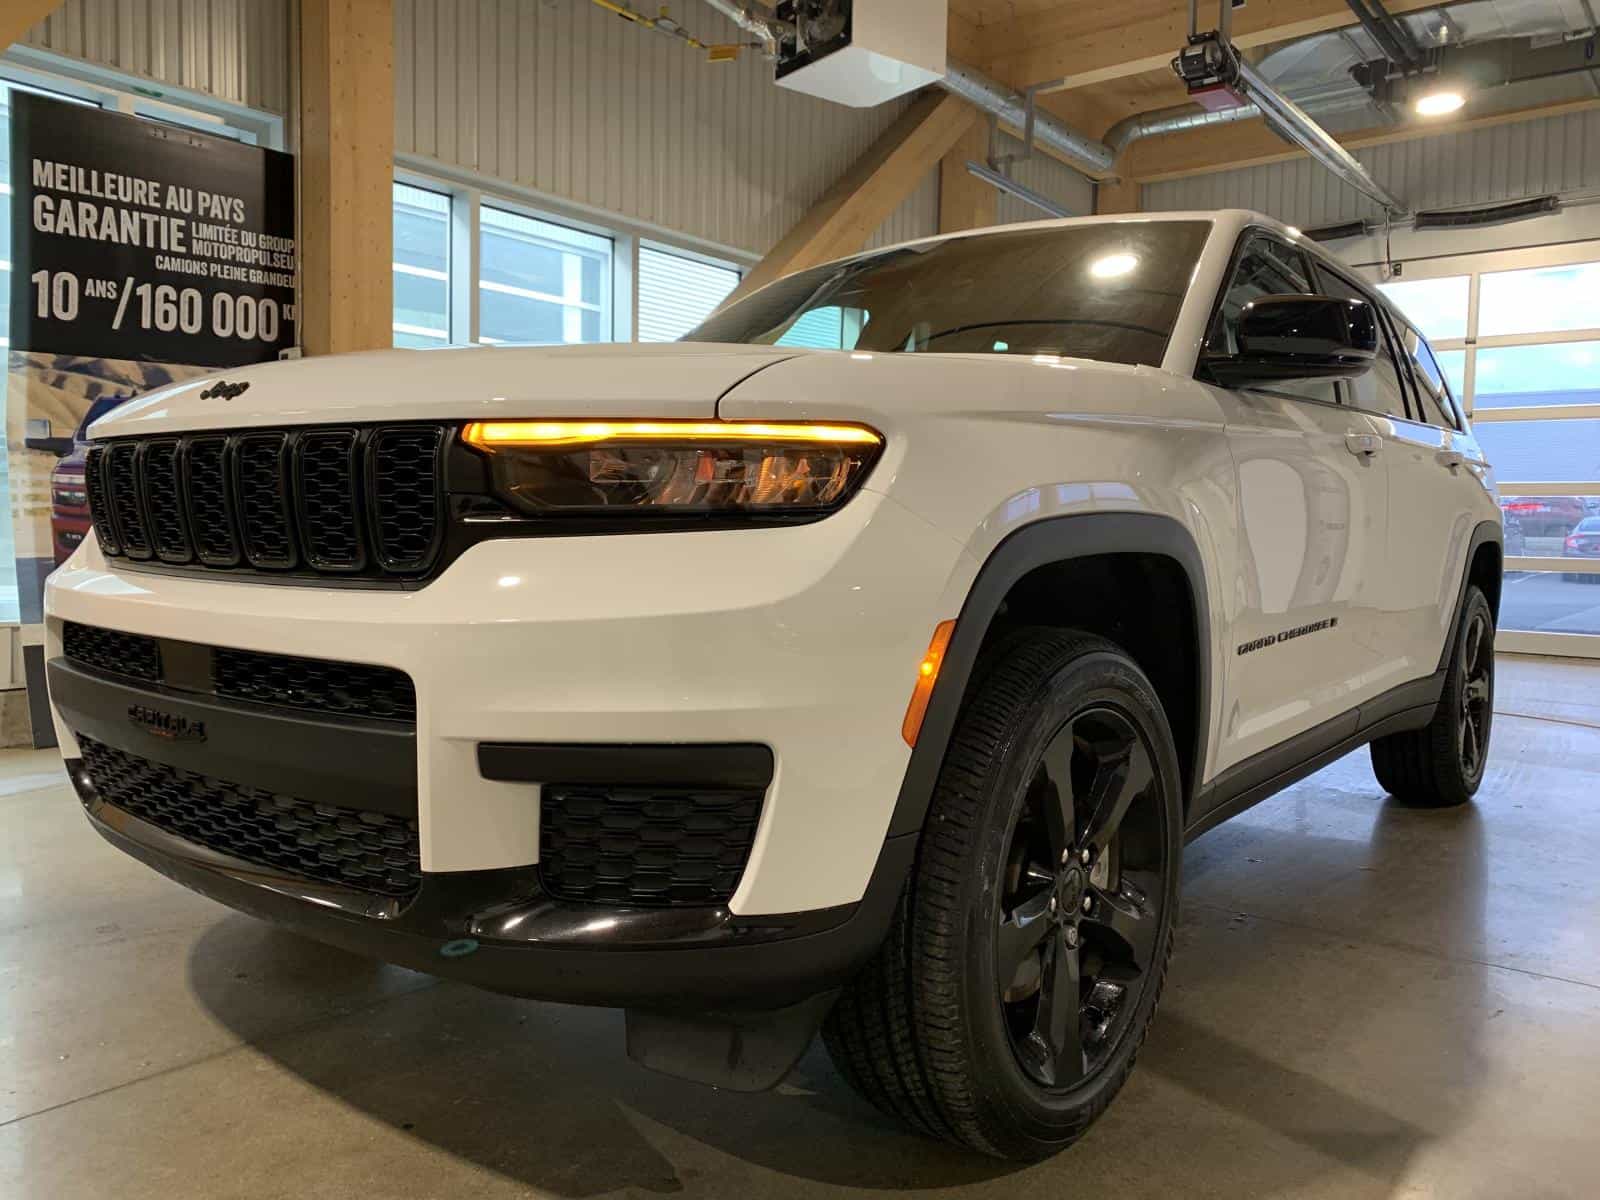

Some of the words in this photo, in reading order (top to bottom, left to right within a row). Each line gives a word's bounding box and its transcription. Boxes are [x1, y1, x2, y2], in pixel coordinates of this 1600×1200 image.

[33, 159, 161, 208] MEILLEURE
[166, 185, 192, 213] AU
[198, 191, 245, 223] PAYS
[33, 194, 187, 253] GARANTIE
[192, 221, 239, 245] LIMITÉE
[240, 230, 257, 247] DU
[155, 254, 208, 276] CAMIONS
[209, 263, 248, 282] PLEINE
[31, 269, 79, 321] 10
[85, 278, 118, 299] ANS
[212, 292, 279, 342] 000
[1237, 635, 1276, 656] GRAND
[1277, 619, 1329, 643] CHEROKEE
